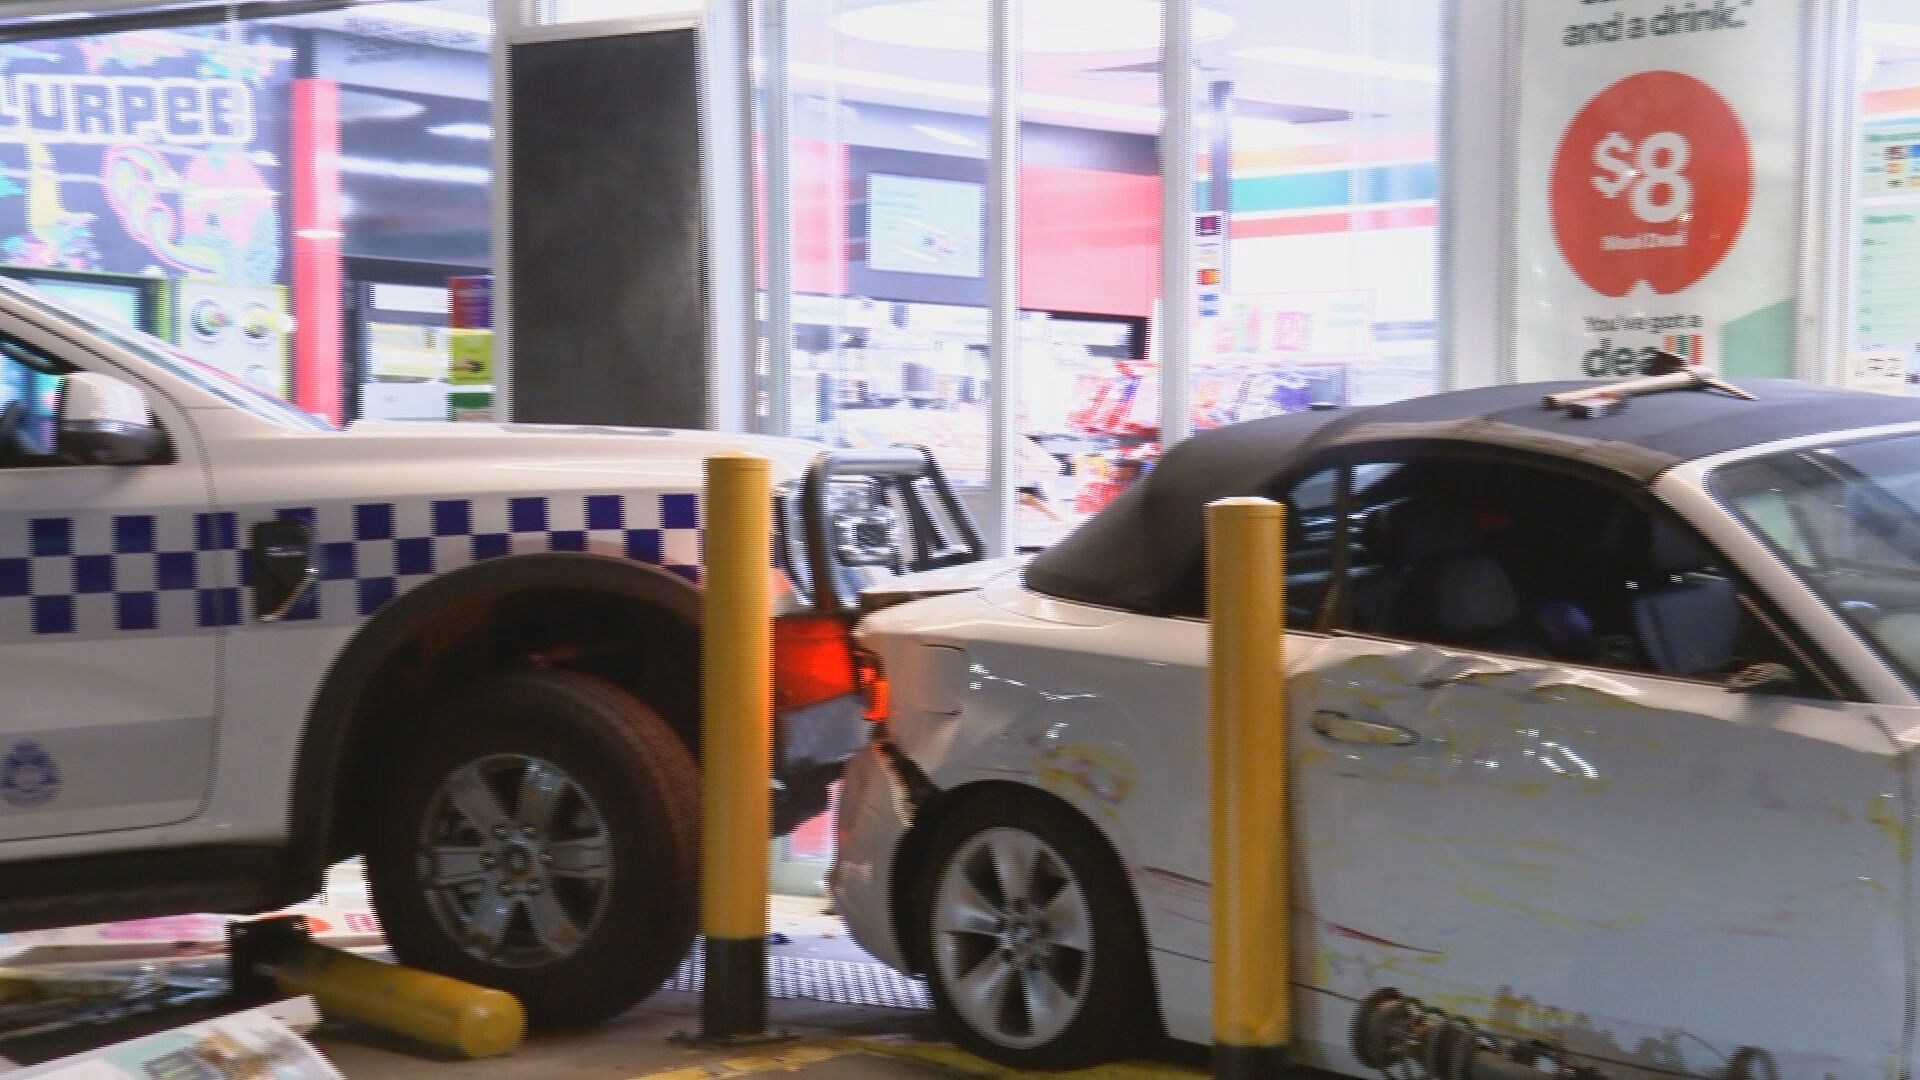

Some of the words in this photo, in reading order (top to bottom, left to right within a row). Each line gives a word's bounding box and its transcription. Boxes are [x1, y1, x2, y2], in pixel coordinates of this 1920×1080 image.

[1562, 12, 1625, 46] and
[1626, 17, 1648, 40] a
[1588, 131, 1694, 223] $8
[1600, 233, 1644, 250] Meal
[1642, 230, 1688, 248] Deal
[1582, 313, 1648, 332] You've
[1648, 314, 1687, 334] got
[1687, 314, 1704, 328] a
